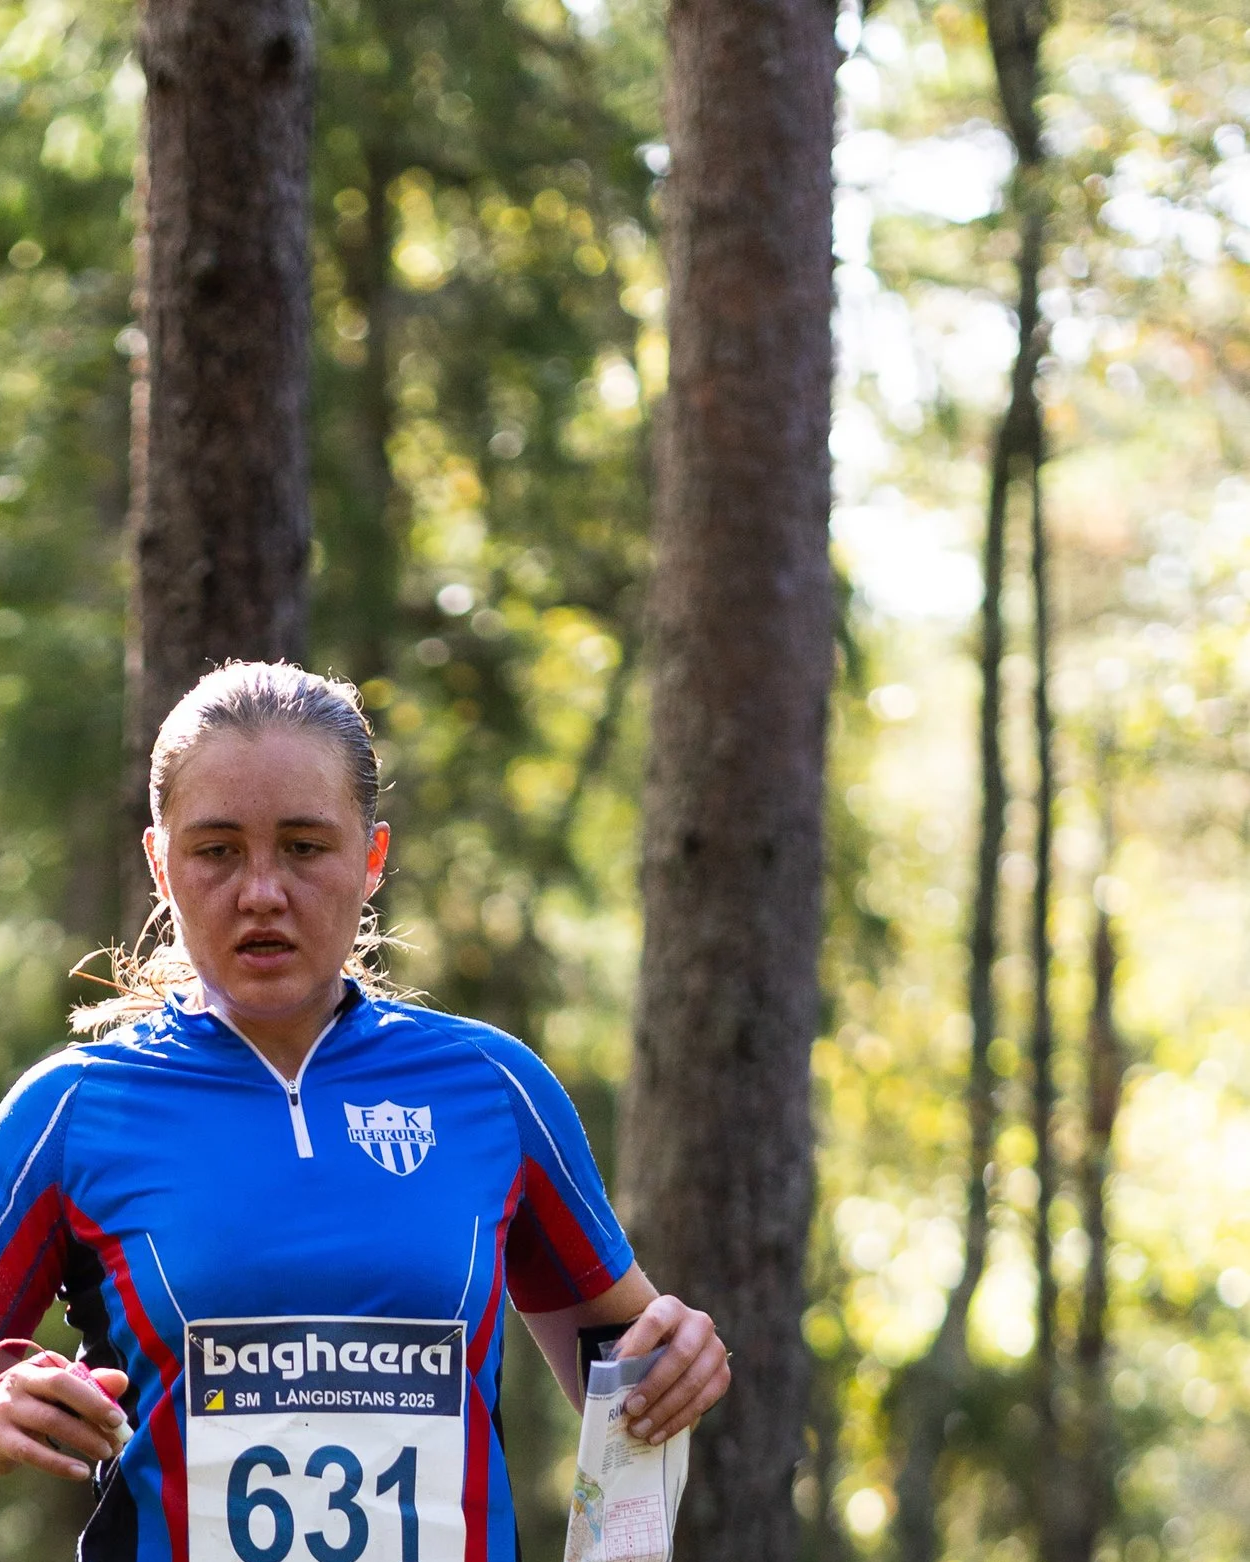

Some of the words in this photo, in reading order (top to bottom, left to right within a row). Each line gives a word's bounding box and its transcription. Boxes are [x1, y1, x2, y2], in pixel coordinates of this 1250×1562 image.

[352, 1129, 432, 1143] HERKULES
[203, 1333, 452, 1380] bagheera
[235, 1390, 260, 1407] SM
[275, 1388, 395, 1406] LÅNGDISTANS
[399, 1392, 435, 1408] 2025
